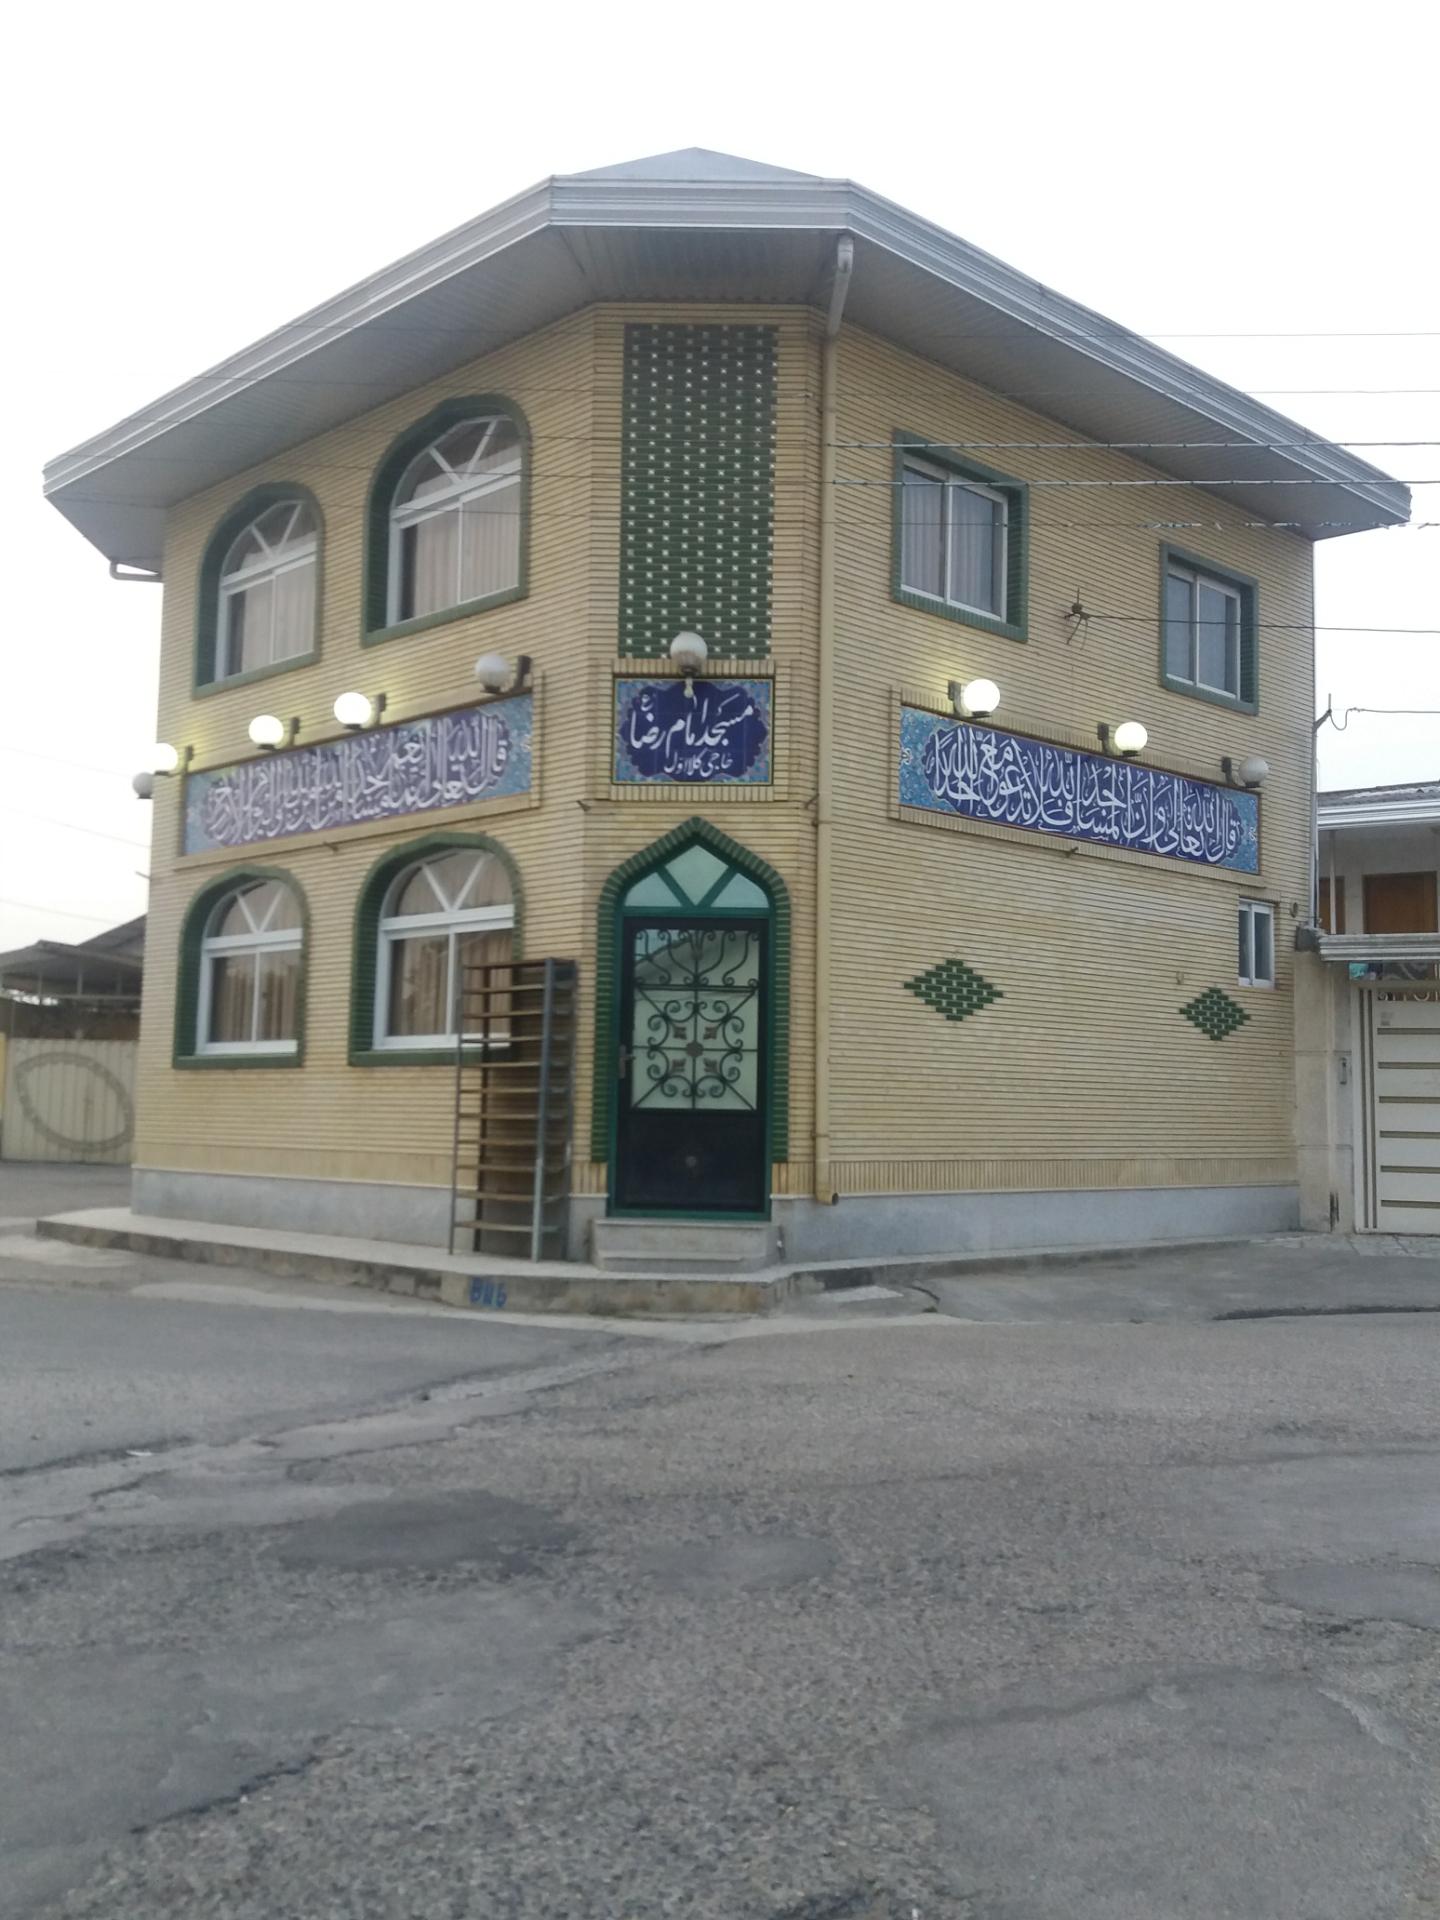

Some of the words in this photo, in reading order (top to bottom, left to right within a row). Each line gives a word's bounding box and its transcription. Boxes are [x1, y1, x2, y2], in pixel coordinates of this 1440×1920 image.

[630, 709, 666, 750] رضا
[666, 698, 709, 759] امام
[696, 697, 753, 747] مسجد
